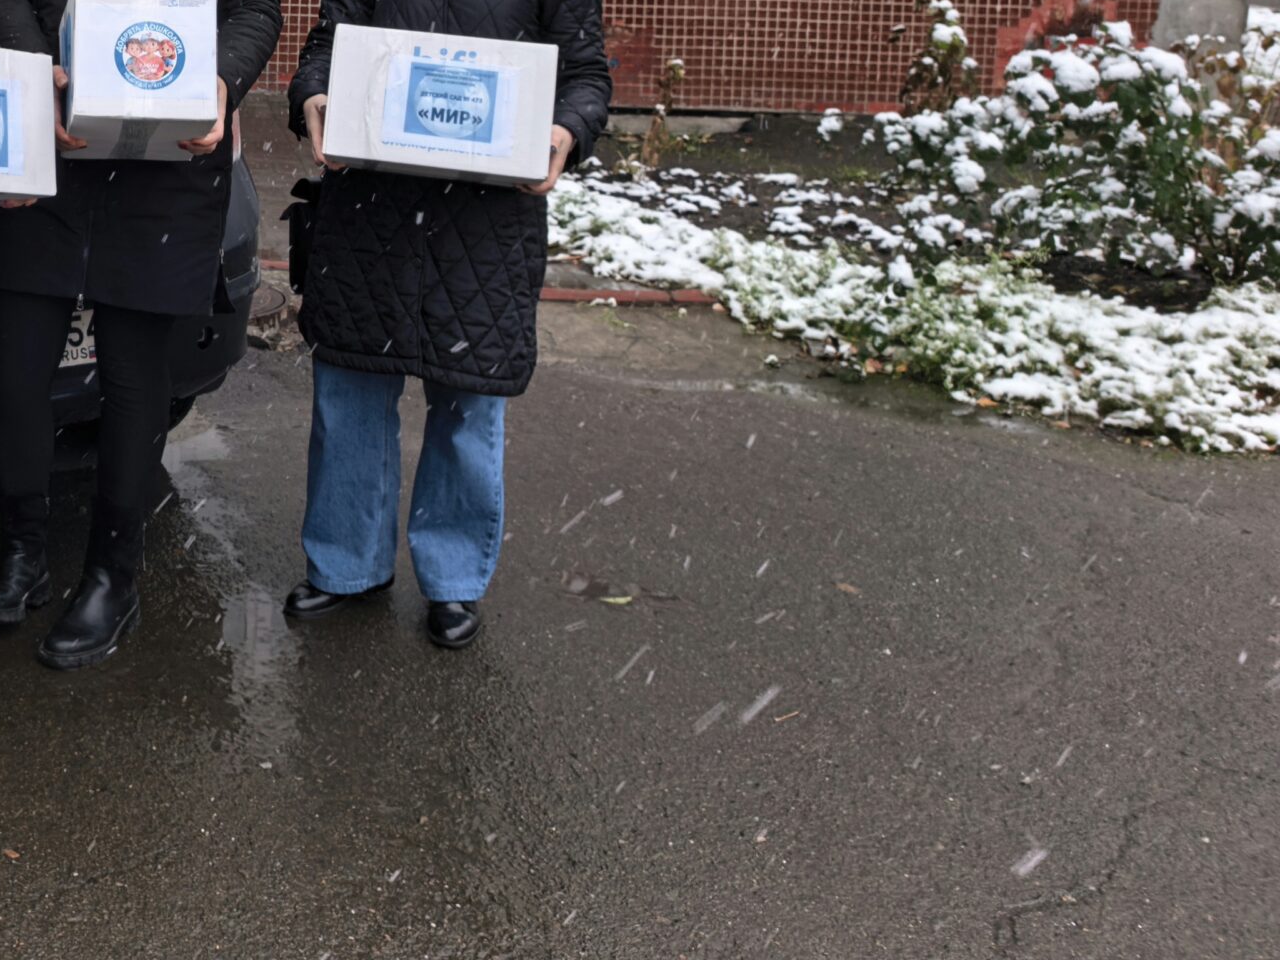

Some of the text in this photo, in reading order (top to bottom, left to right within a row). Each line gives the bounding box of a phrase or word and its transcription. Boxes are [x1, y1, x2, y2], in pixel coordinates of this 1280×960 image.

[420, 90, 449, 100] ДЕТСКИЙ
[449, 93, 463, 102] САД
[471, 96, 483, 104] 473
[418, 107, 483, 125] «МИР»
